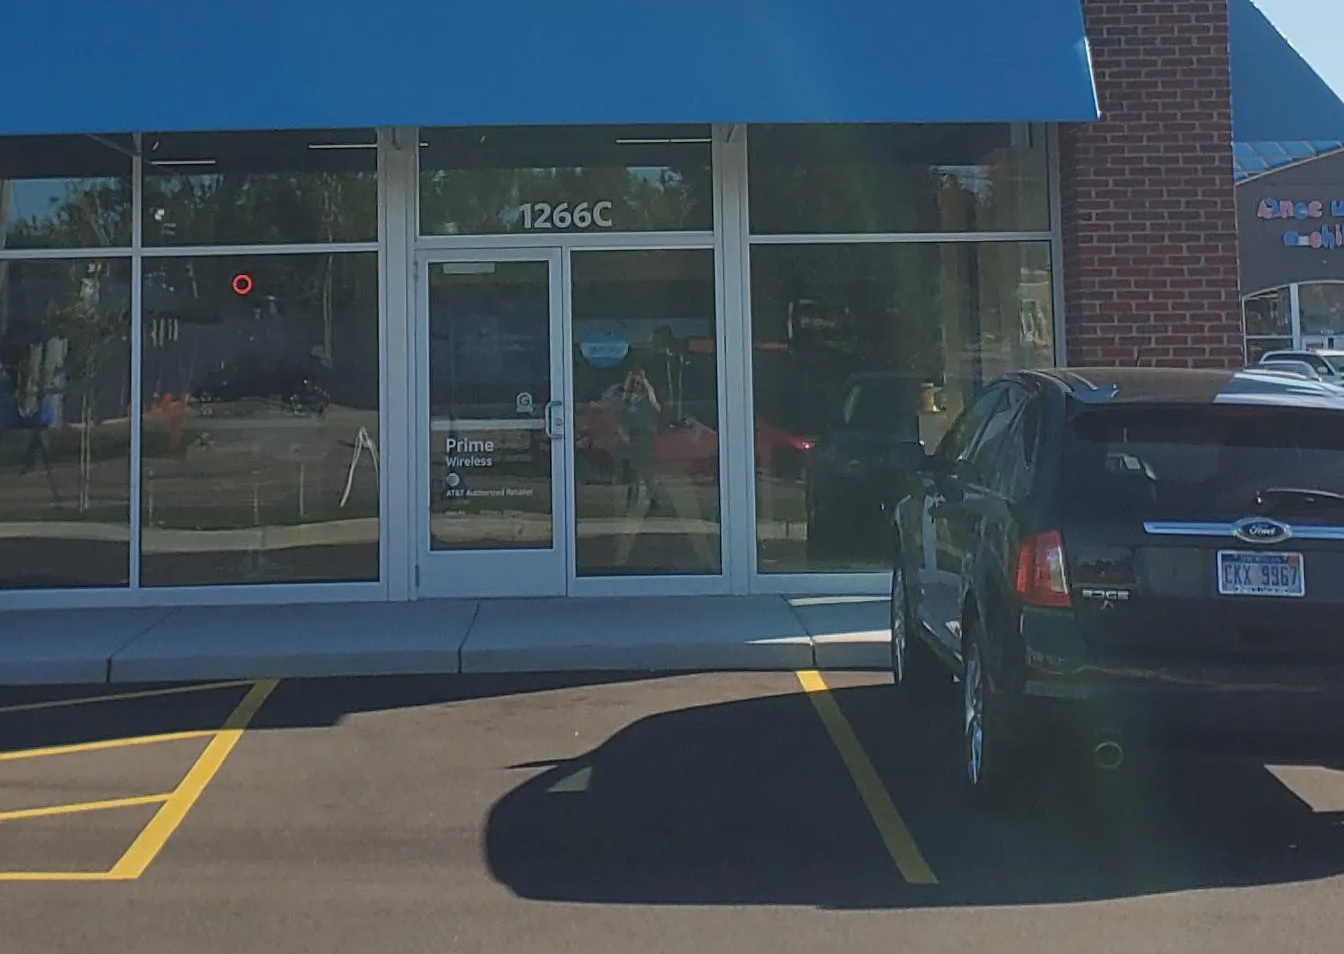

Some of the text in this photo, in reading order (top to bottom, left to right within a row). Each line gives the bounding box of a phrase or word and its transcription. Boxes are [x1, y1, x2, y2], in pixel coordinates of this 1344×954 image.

[519, 201, 613, 229] 1266C
[446, 438, 495, 453] Prime
[445, 455, 493, 467] Wireless
[1248, 524, 1276, 536] Ford
